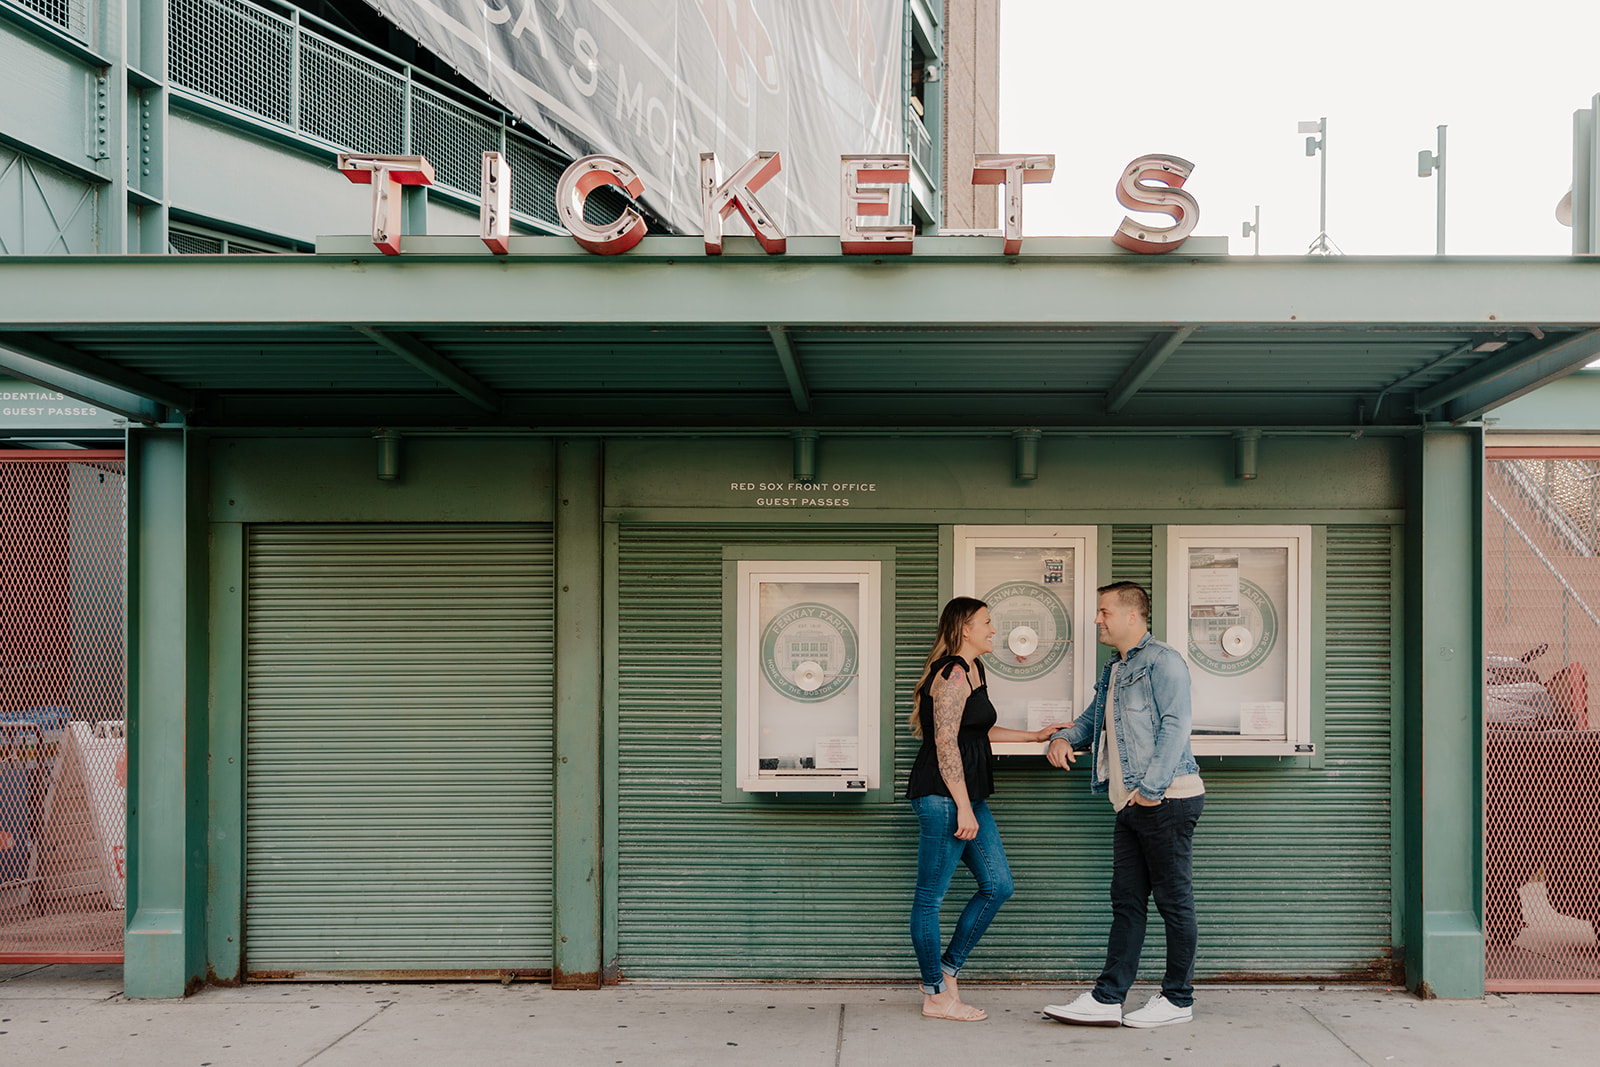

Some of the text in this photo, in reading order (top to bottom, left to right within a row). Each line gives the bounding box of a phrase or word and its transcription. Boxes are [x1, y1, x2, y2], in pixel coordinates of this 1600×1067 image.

[337, 151, 1200, 256] TICKETS
[3, 407, 97, 416] GUEST PASSES
[730, 482, 876, 492] RED SOX FRONT OFFICE
[756, 498, 850, 507] GUEST PASSES
[988, 587, 1058, 612] ENWAY PARK
[772, 608, 848, 634] FENWAY PARK
[1014, 663, 1043, 674] BOSTON
[1221, 658, 1250, 670] BOSTON
